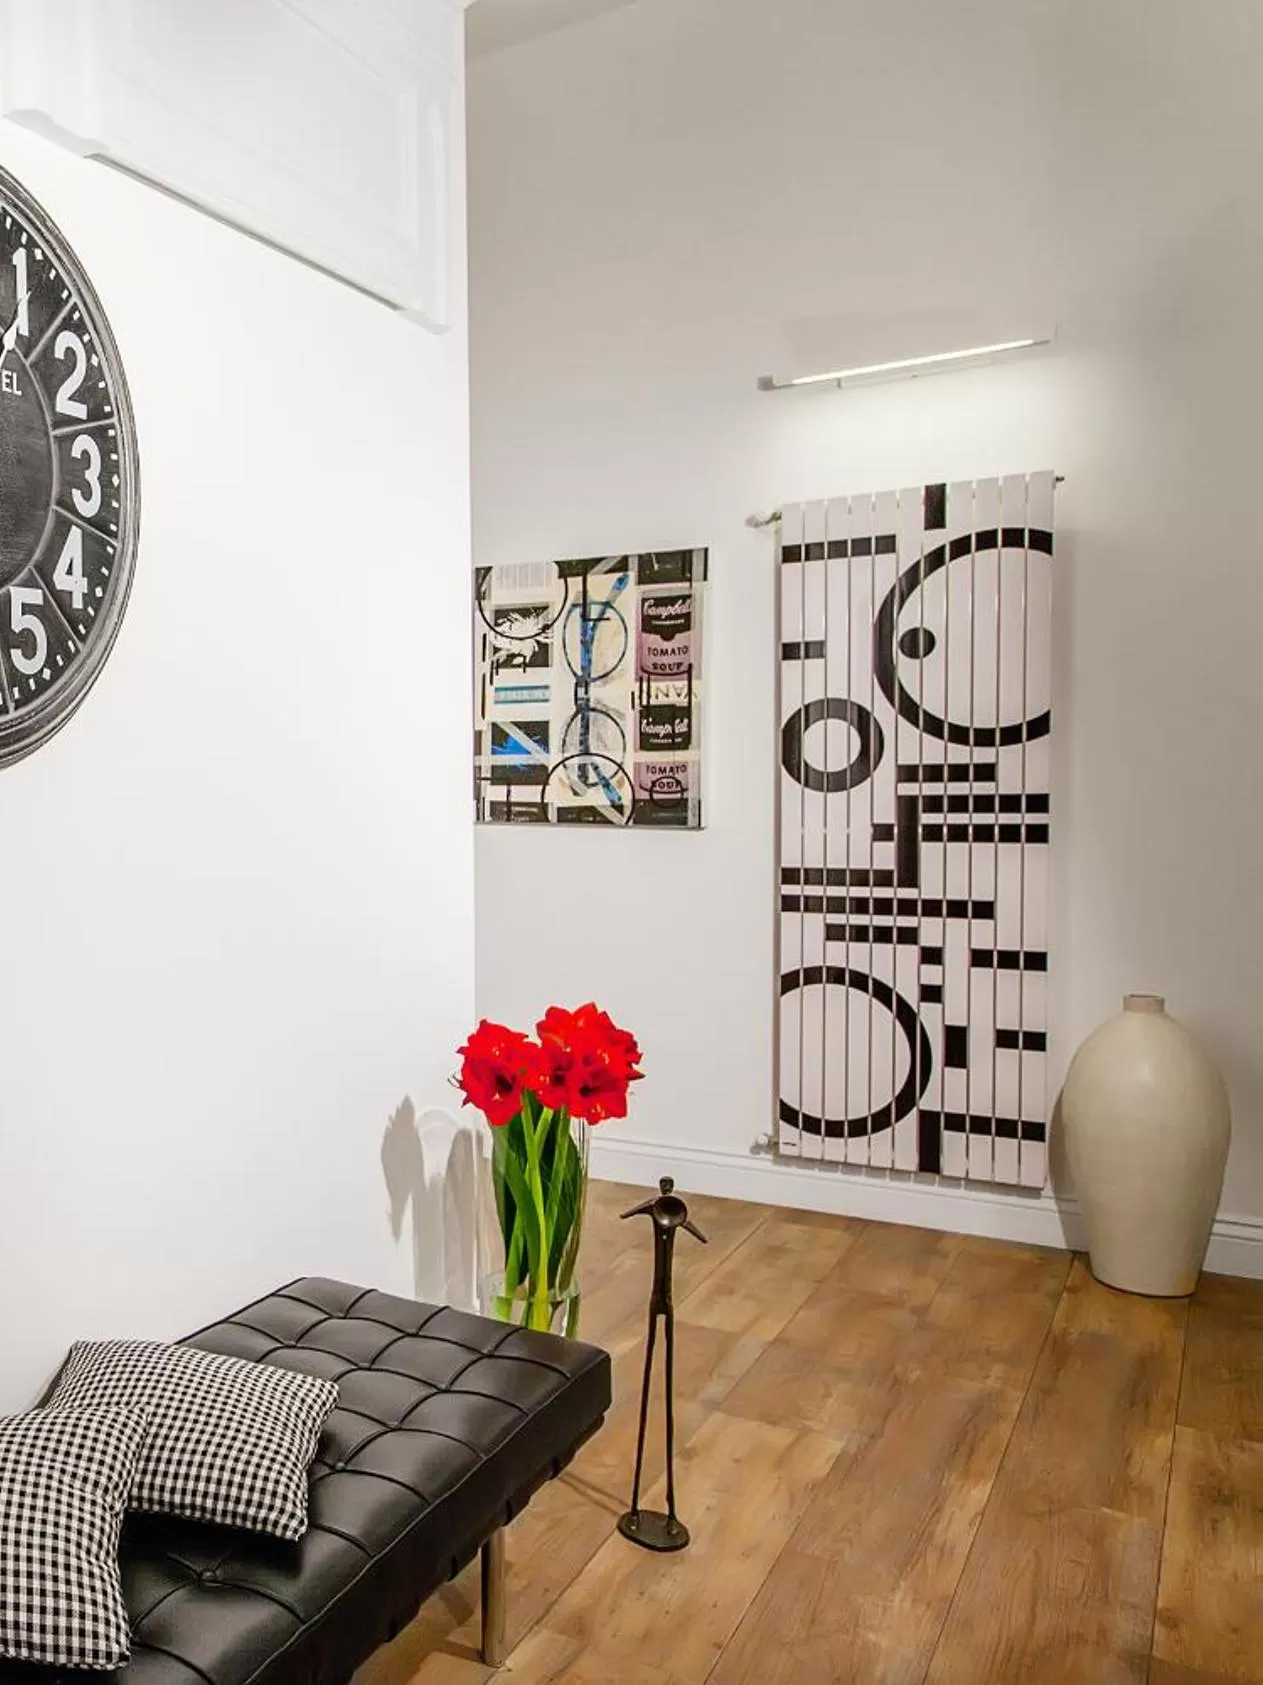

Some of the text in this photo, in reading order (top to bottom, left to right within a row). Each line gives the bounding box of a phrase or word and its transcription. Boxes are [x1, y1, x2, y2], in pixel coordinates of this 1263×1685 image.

[13, 247, 29, 337] 1
[54, 330, 88, 421] 2
[70, 434, 103, 518] 3
[54, 526, 88, 609] 4
[10, 587, 47, 676] 5
[647, 645, 689, 657] TOMATO
[651, 662, 684, 672] SOUP
[646, 764, 688, 775] TOMATO
